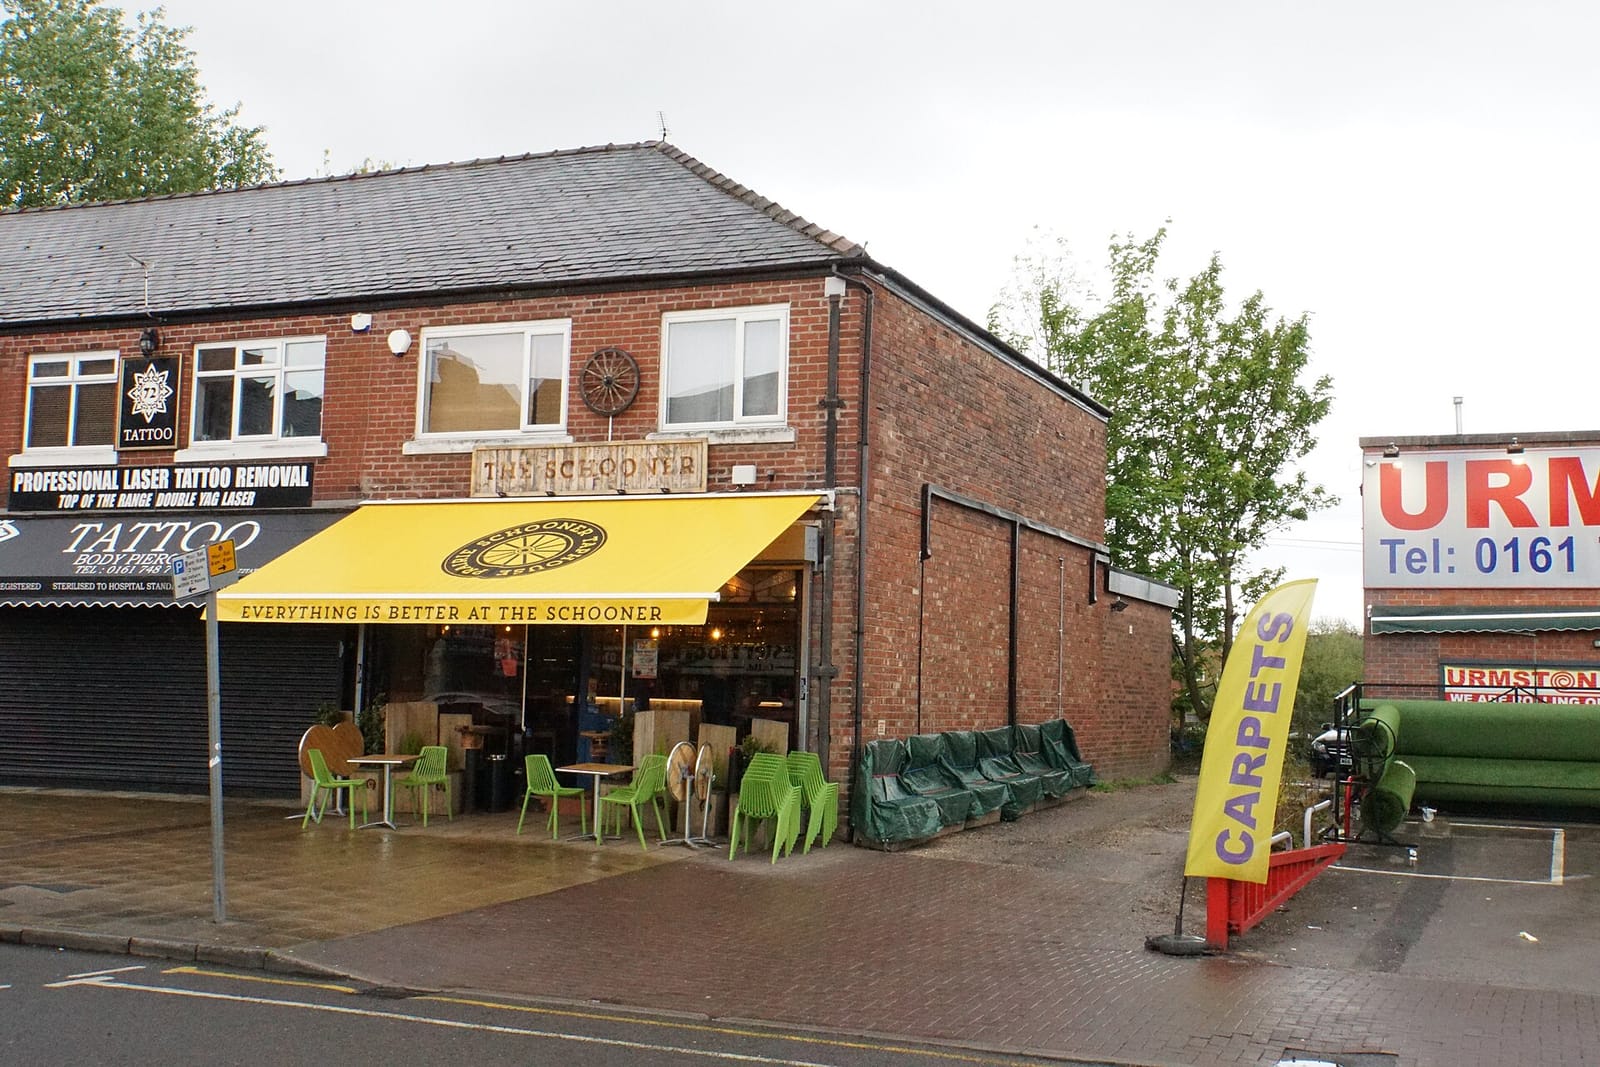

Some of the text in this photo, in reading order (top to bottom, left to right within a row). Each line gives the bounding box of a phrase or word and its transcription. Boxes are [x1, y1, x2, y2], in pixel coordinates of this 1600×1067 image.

[143, 387, 157, 399] 72
[123, 427, 173, 441] TATTOO
[484, 455, 695, 480] THE SCHOONER
[13, 465, 309, 493] PROFESSIONAL LASER TATTOO REMOVAL
[58, 491, 256, 508] TOP OF THE RANGE DOUBLE YAG LASER
[1380, 456, 1600, 530] URM
[62, 520, 261, 553] TATTOO
[451, 548, 489, 576] PRAIRIE
[477, 521, 594, 546] SCHOONER
[1380, 535, 1575, 574] Tel: 0161
[73, 553, 126, 565] BODY
[106, 565, 136, 574] 0161
[138, 565, 162, 574] 748
[52, 582, 95, 591] STERILISED
[96, 582, 107, 591] TO
[109, 582, 145, 591] HOSPITAL
[241, 605, 662, 621] EVERYTHING IS BETTER AT THE SCHOONER
[1447, 669, 1597, 688] URMSTON
[1450, 693, 1473, 702] WE
[1216, 612, 1294, 865] CARPETS
